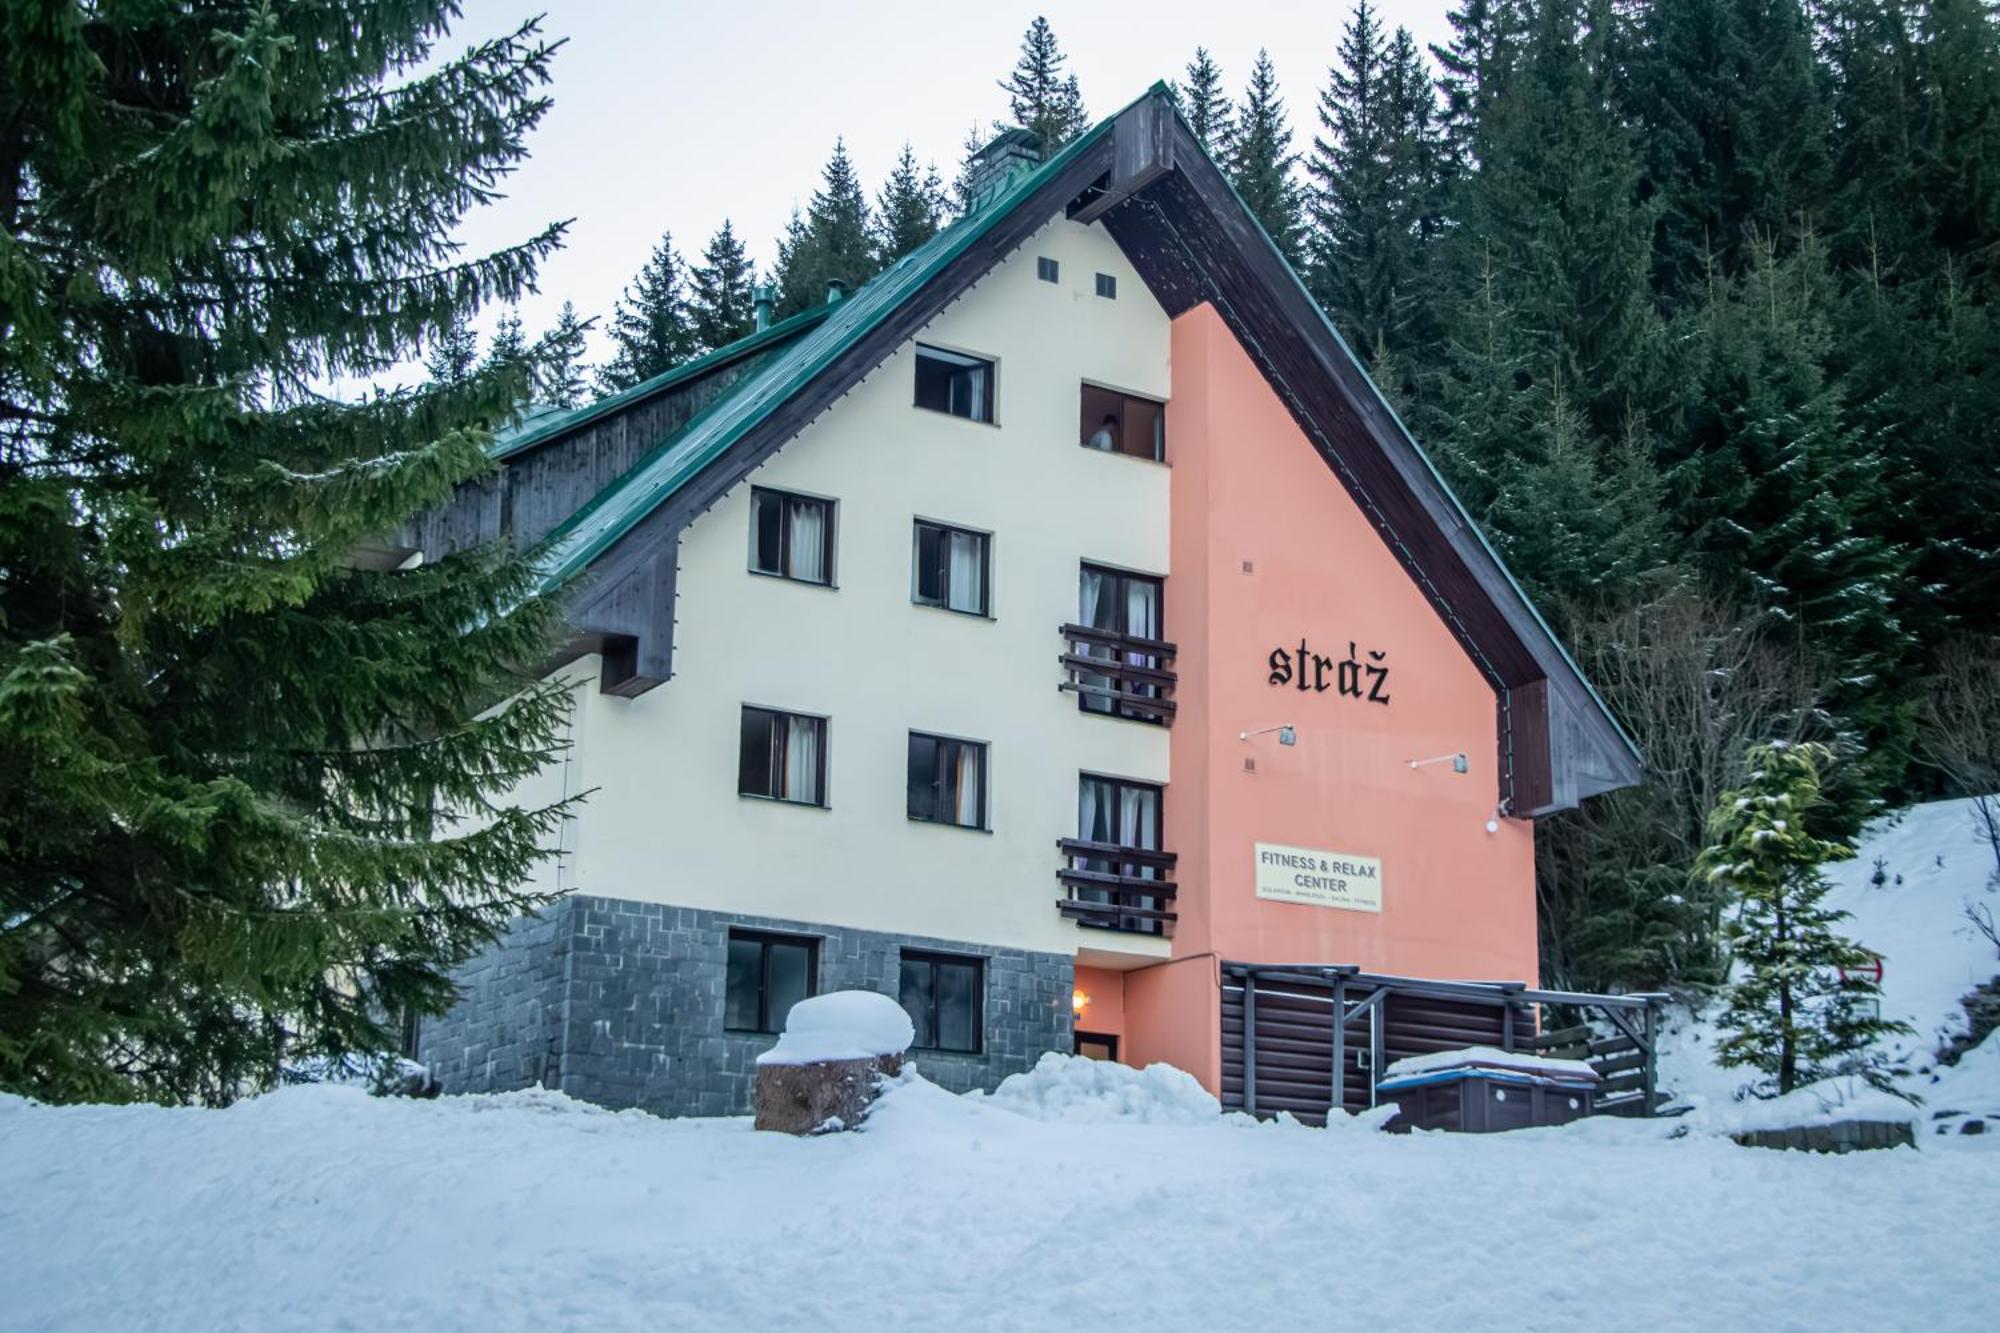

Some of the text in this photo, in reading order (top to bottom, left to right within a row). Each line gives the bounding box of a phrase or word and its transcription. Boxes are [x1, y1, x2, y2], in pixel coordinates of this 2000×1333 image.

[1269, 638, 1390, 705] stráž
[1261, 851, 1376, 879] FITNESS & RELAX
[1294, 874, 1347, 892] CENTER
